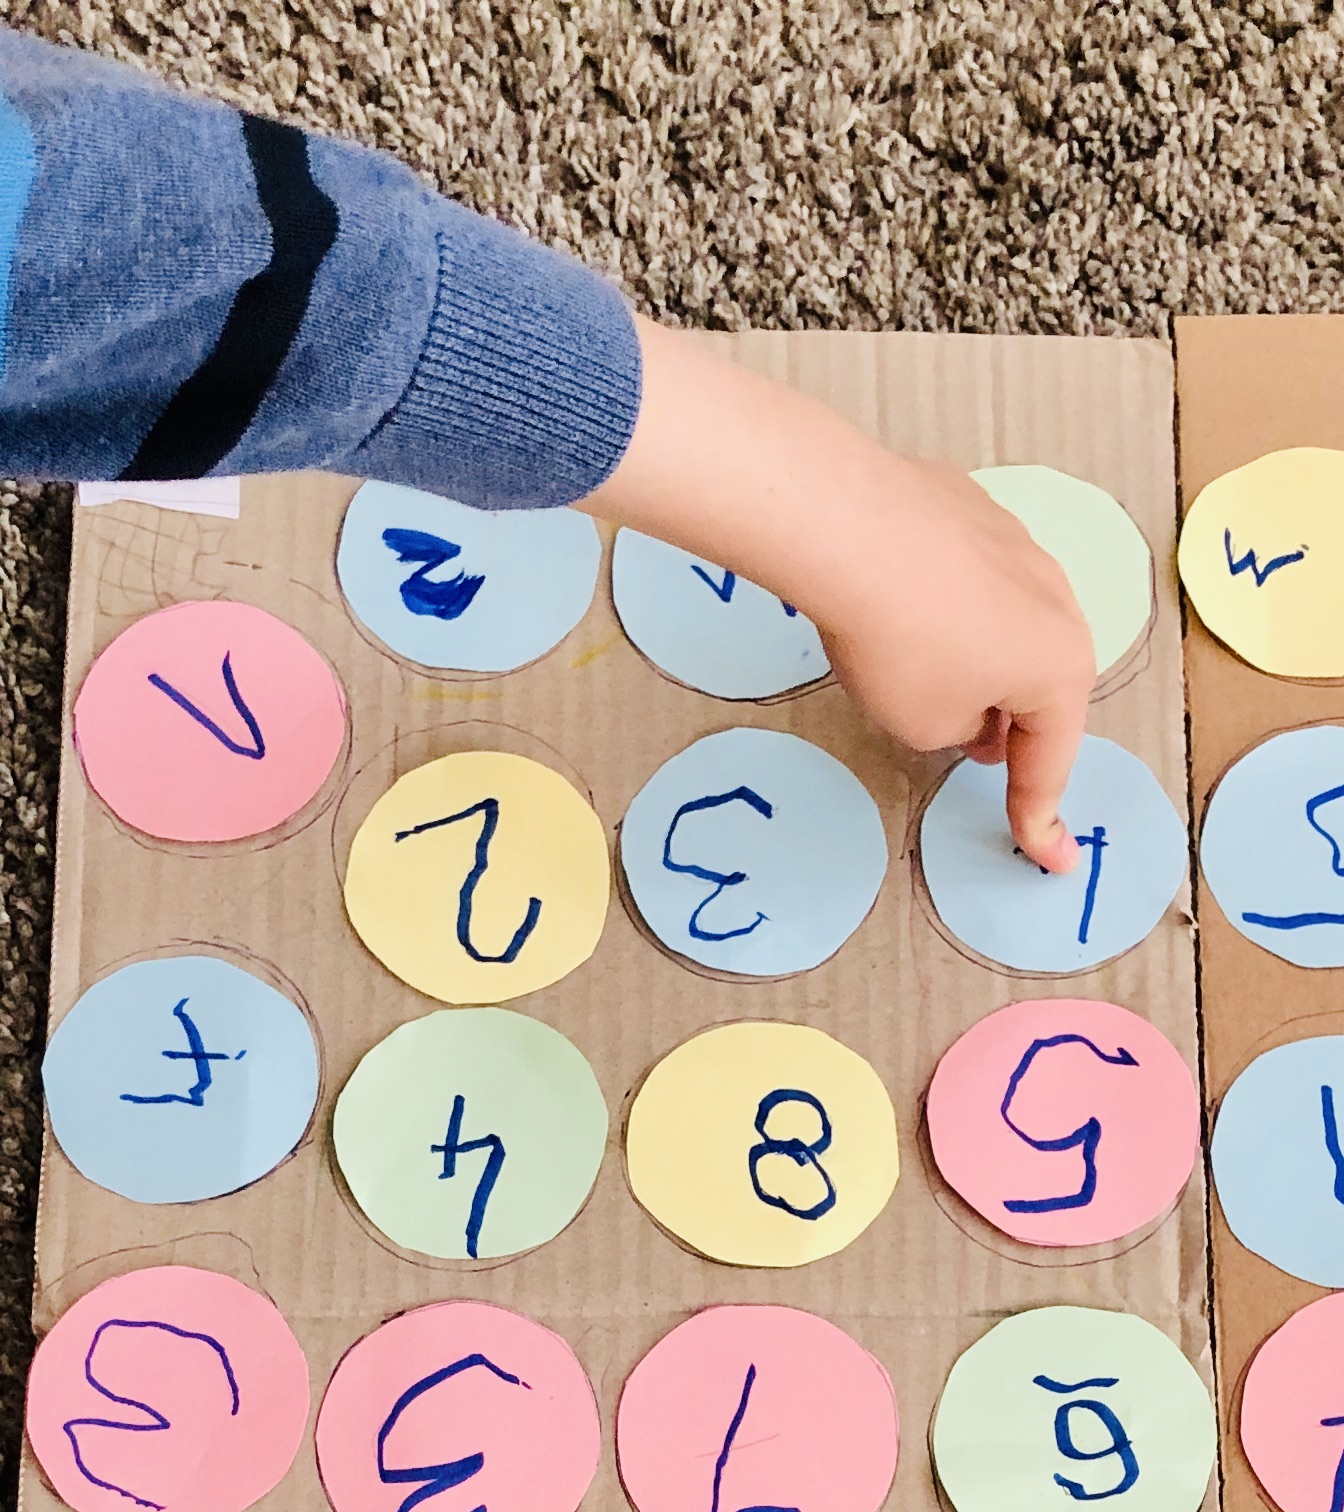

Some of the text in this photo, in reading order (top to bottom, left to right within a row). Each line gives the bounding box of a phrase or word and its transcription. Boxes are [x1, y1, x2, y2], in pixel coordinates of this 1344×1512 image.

[394, 797, 542, 962] 2
[661, 786, 774, 943] 3
[430, 1095, 506, 1258] 4
[748, 1088, 836, 1220] 8
[1001, 1034, 1138, 1213] 5
